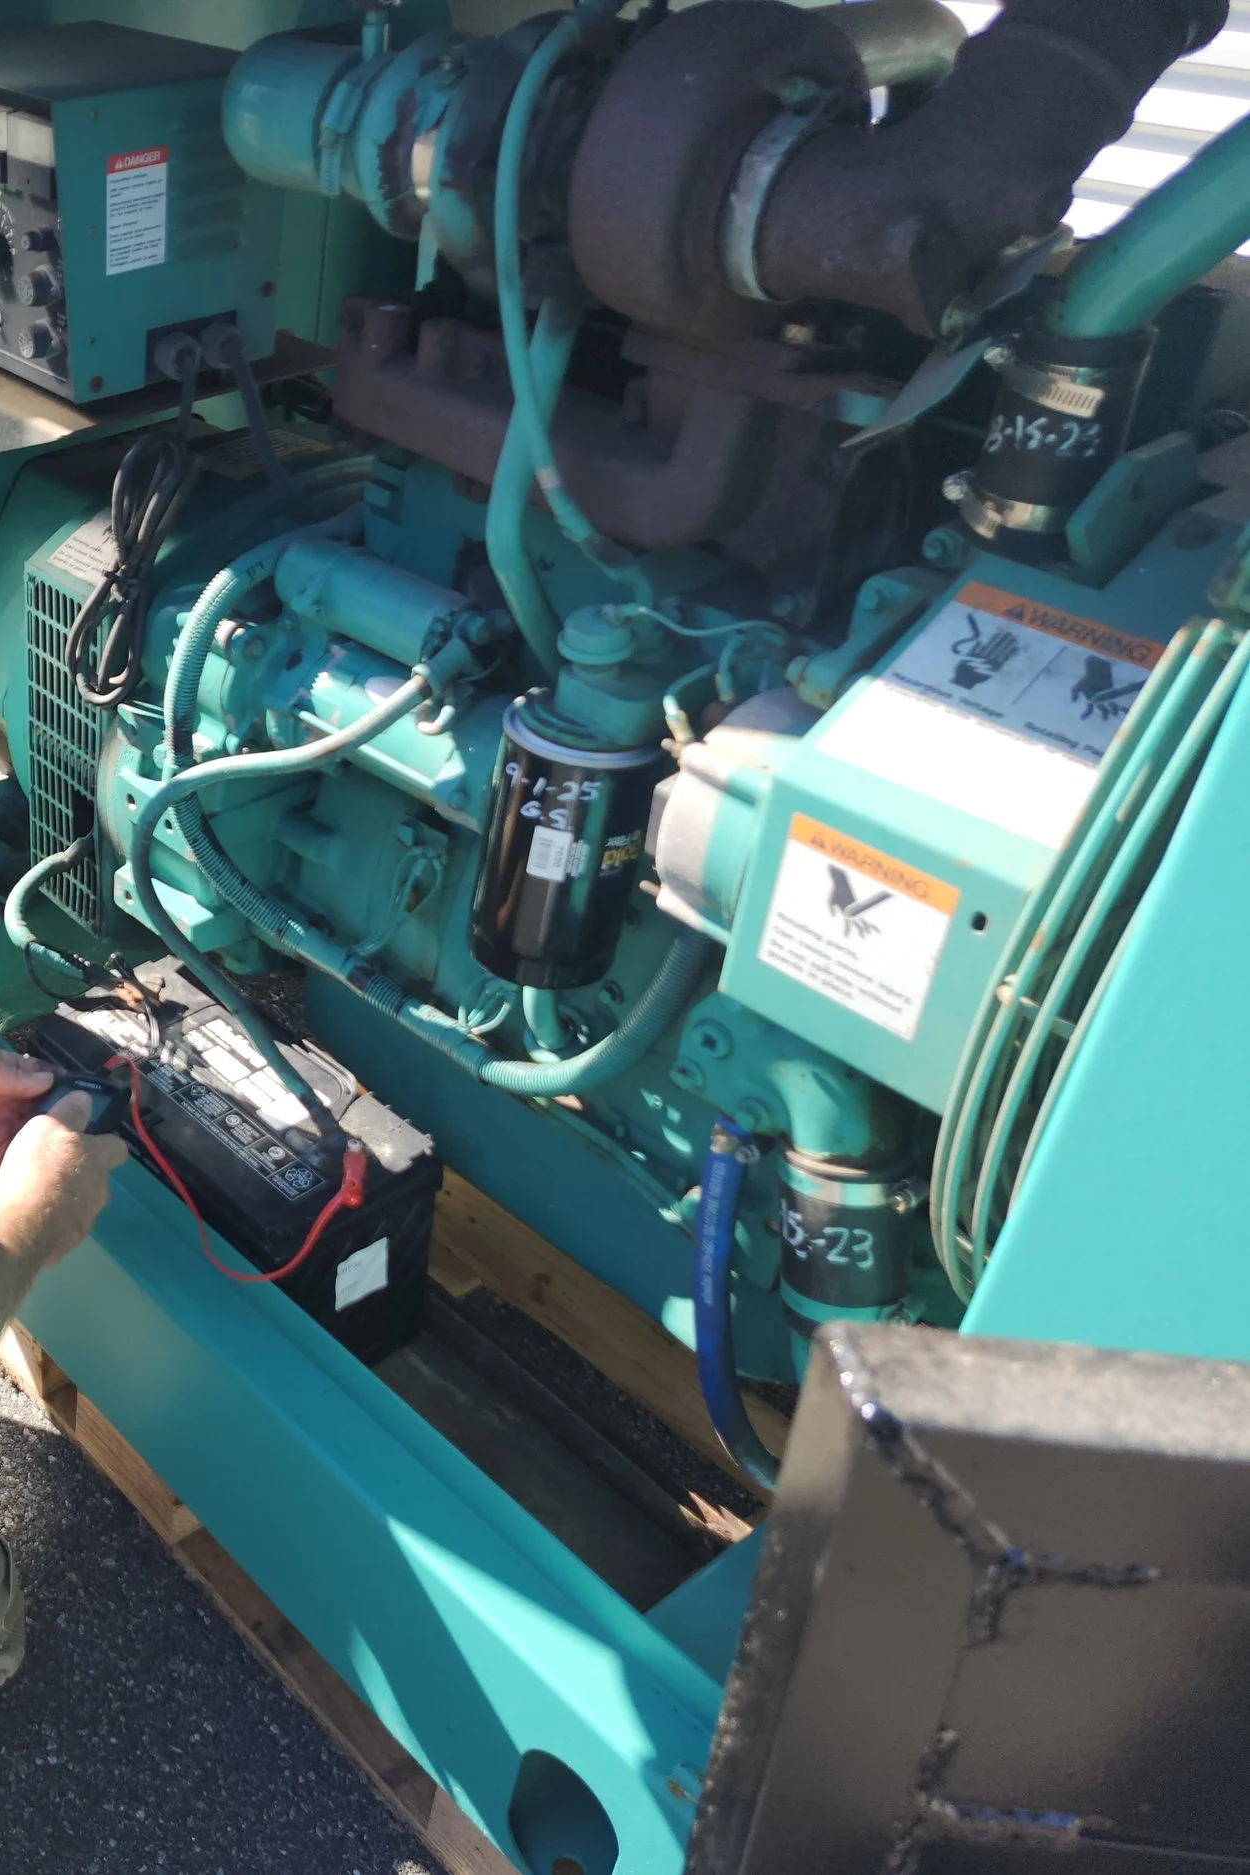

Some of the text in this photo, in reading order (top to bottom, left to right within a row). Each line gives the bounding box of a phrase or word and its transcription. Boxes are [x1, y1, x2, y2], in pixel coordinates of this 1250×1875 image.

[124, 150, 161, 168] DANGER
[1028, 606, 1152, 666] WARNING
[505, 762, 603, 801] 9-1-25
[831, 841, 929, 899] WARNING
